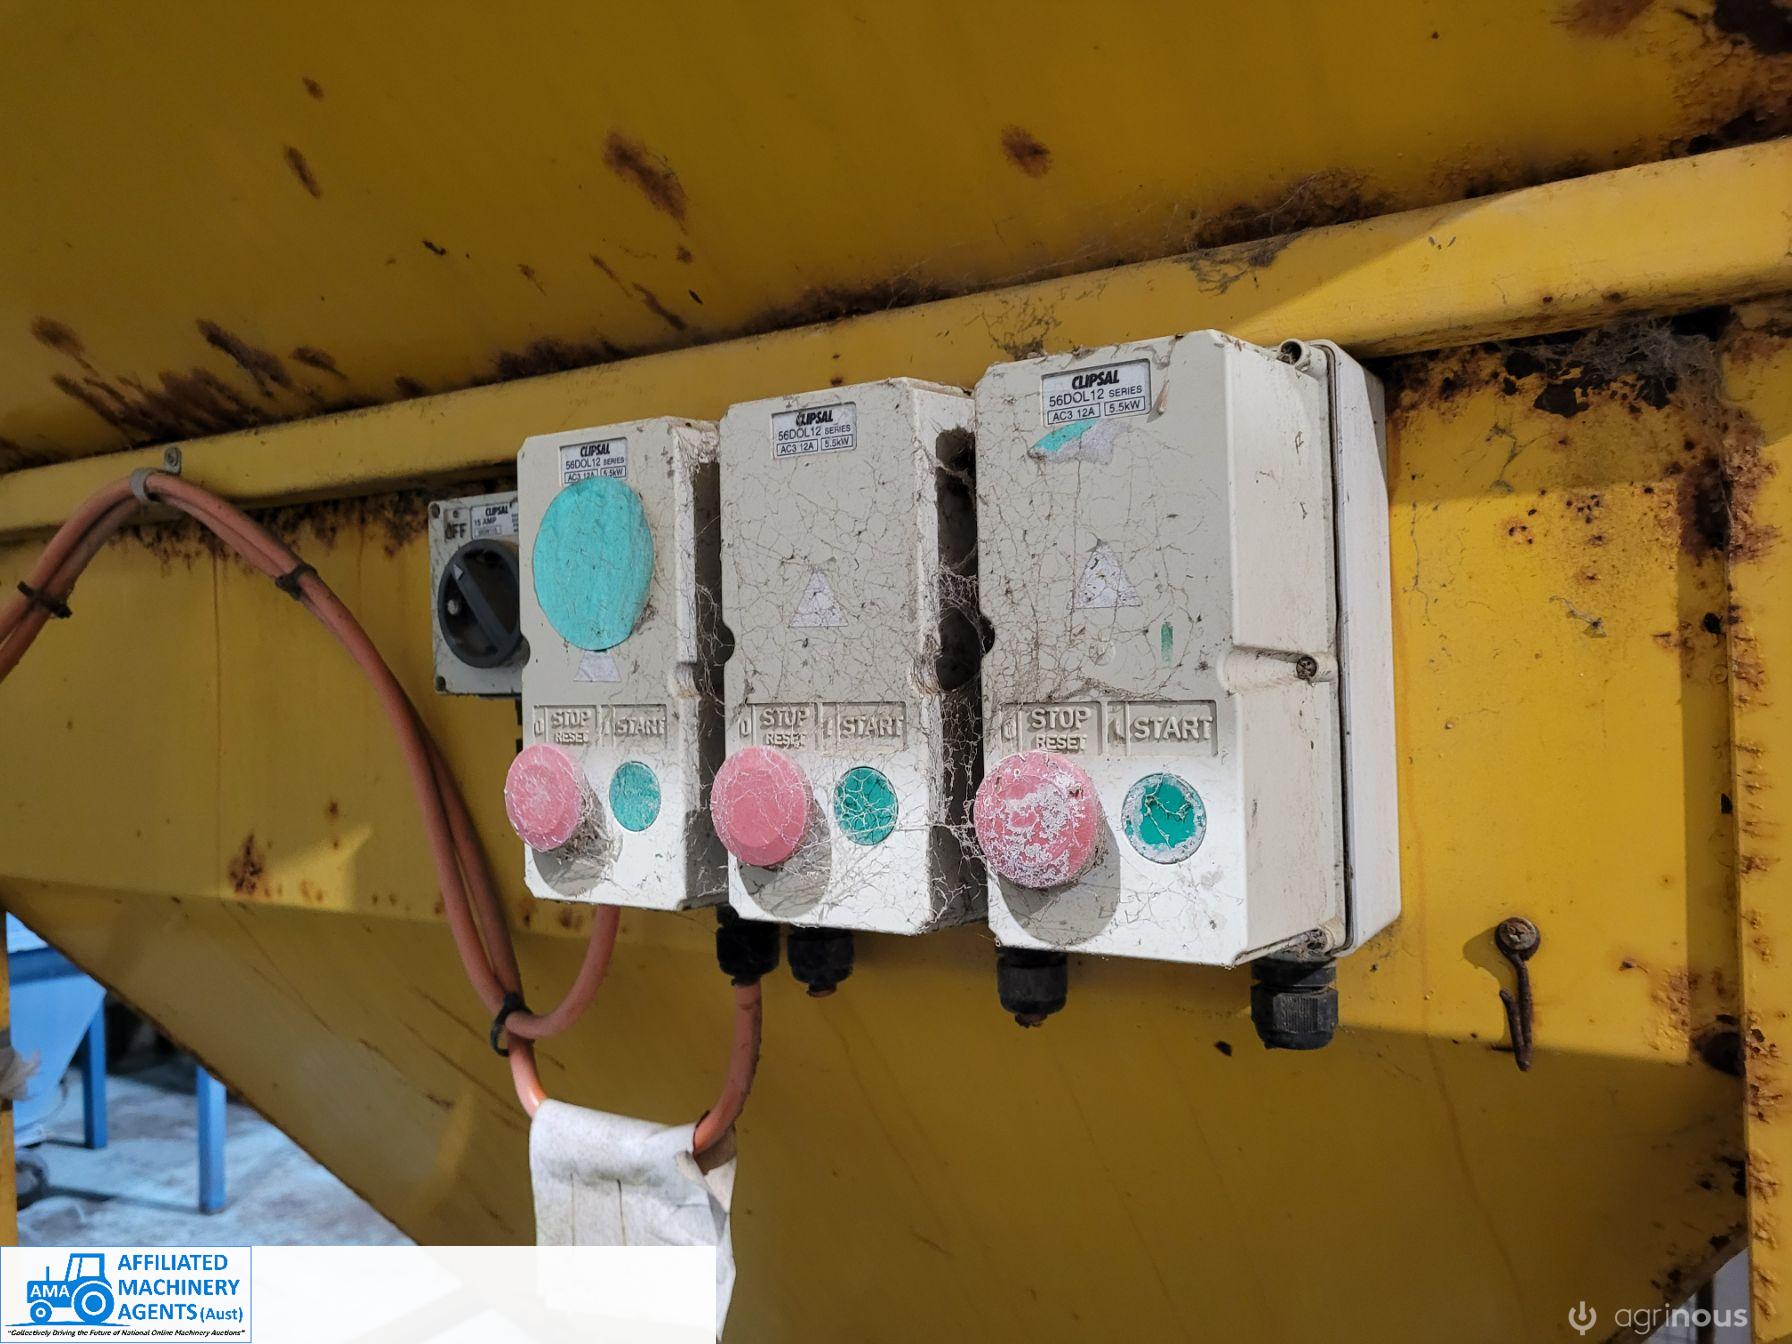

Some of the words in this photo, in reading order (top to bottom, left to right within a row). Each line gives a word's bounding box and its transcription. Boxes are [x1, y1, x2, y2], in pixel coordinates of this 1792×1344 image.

[1072, 370, 1119, 389] CLIPSAL
[1049, 388, 1104, 407] 56DOL12
[1108, 385, 1142, 398] SERIES
[1052, 410, 1072, 421] AC3
[1077, 407, 1095, 418] 12A
[1109, 400, 1140, 413] 5.5kW
[796, 410, 833, 426] CLIPSAL
[778, 422, 821, 441] 56DOL12
[824, 424, 850, 435] SERIES
[580, 443, 610, 457] CLIPSAL
[780, 444, 796, 453] AC3
[801, 442, 814, 451] 12A
[824, 436, 849, 448] 5.5kW
[565, 457, 601, 470] 56DOL12
[603, 457, 625, 465] SERIES
[603, 469, 623, 477] 55kW
[485, 505, 508, 516] CLIPSAL
[483, 517, 496, 525] AMP
[445, 522, 466, 539] OFF
[551, 710, 591, 729] STOP
[760, 707, 811, 730] STOP
[1030, 706, 1092, 730] STOP
[614, 717, 665, 737] START
[841, 715, 904, 738] START
[1132, 716, 1213, 740] START
[765, 733, 807, 749] RESET
[1033, 734, 1087, 750] RESET
